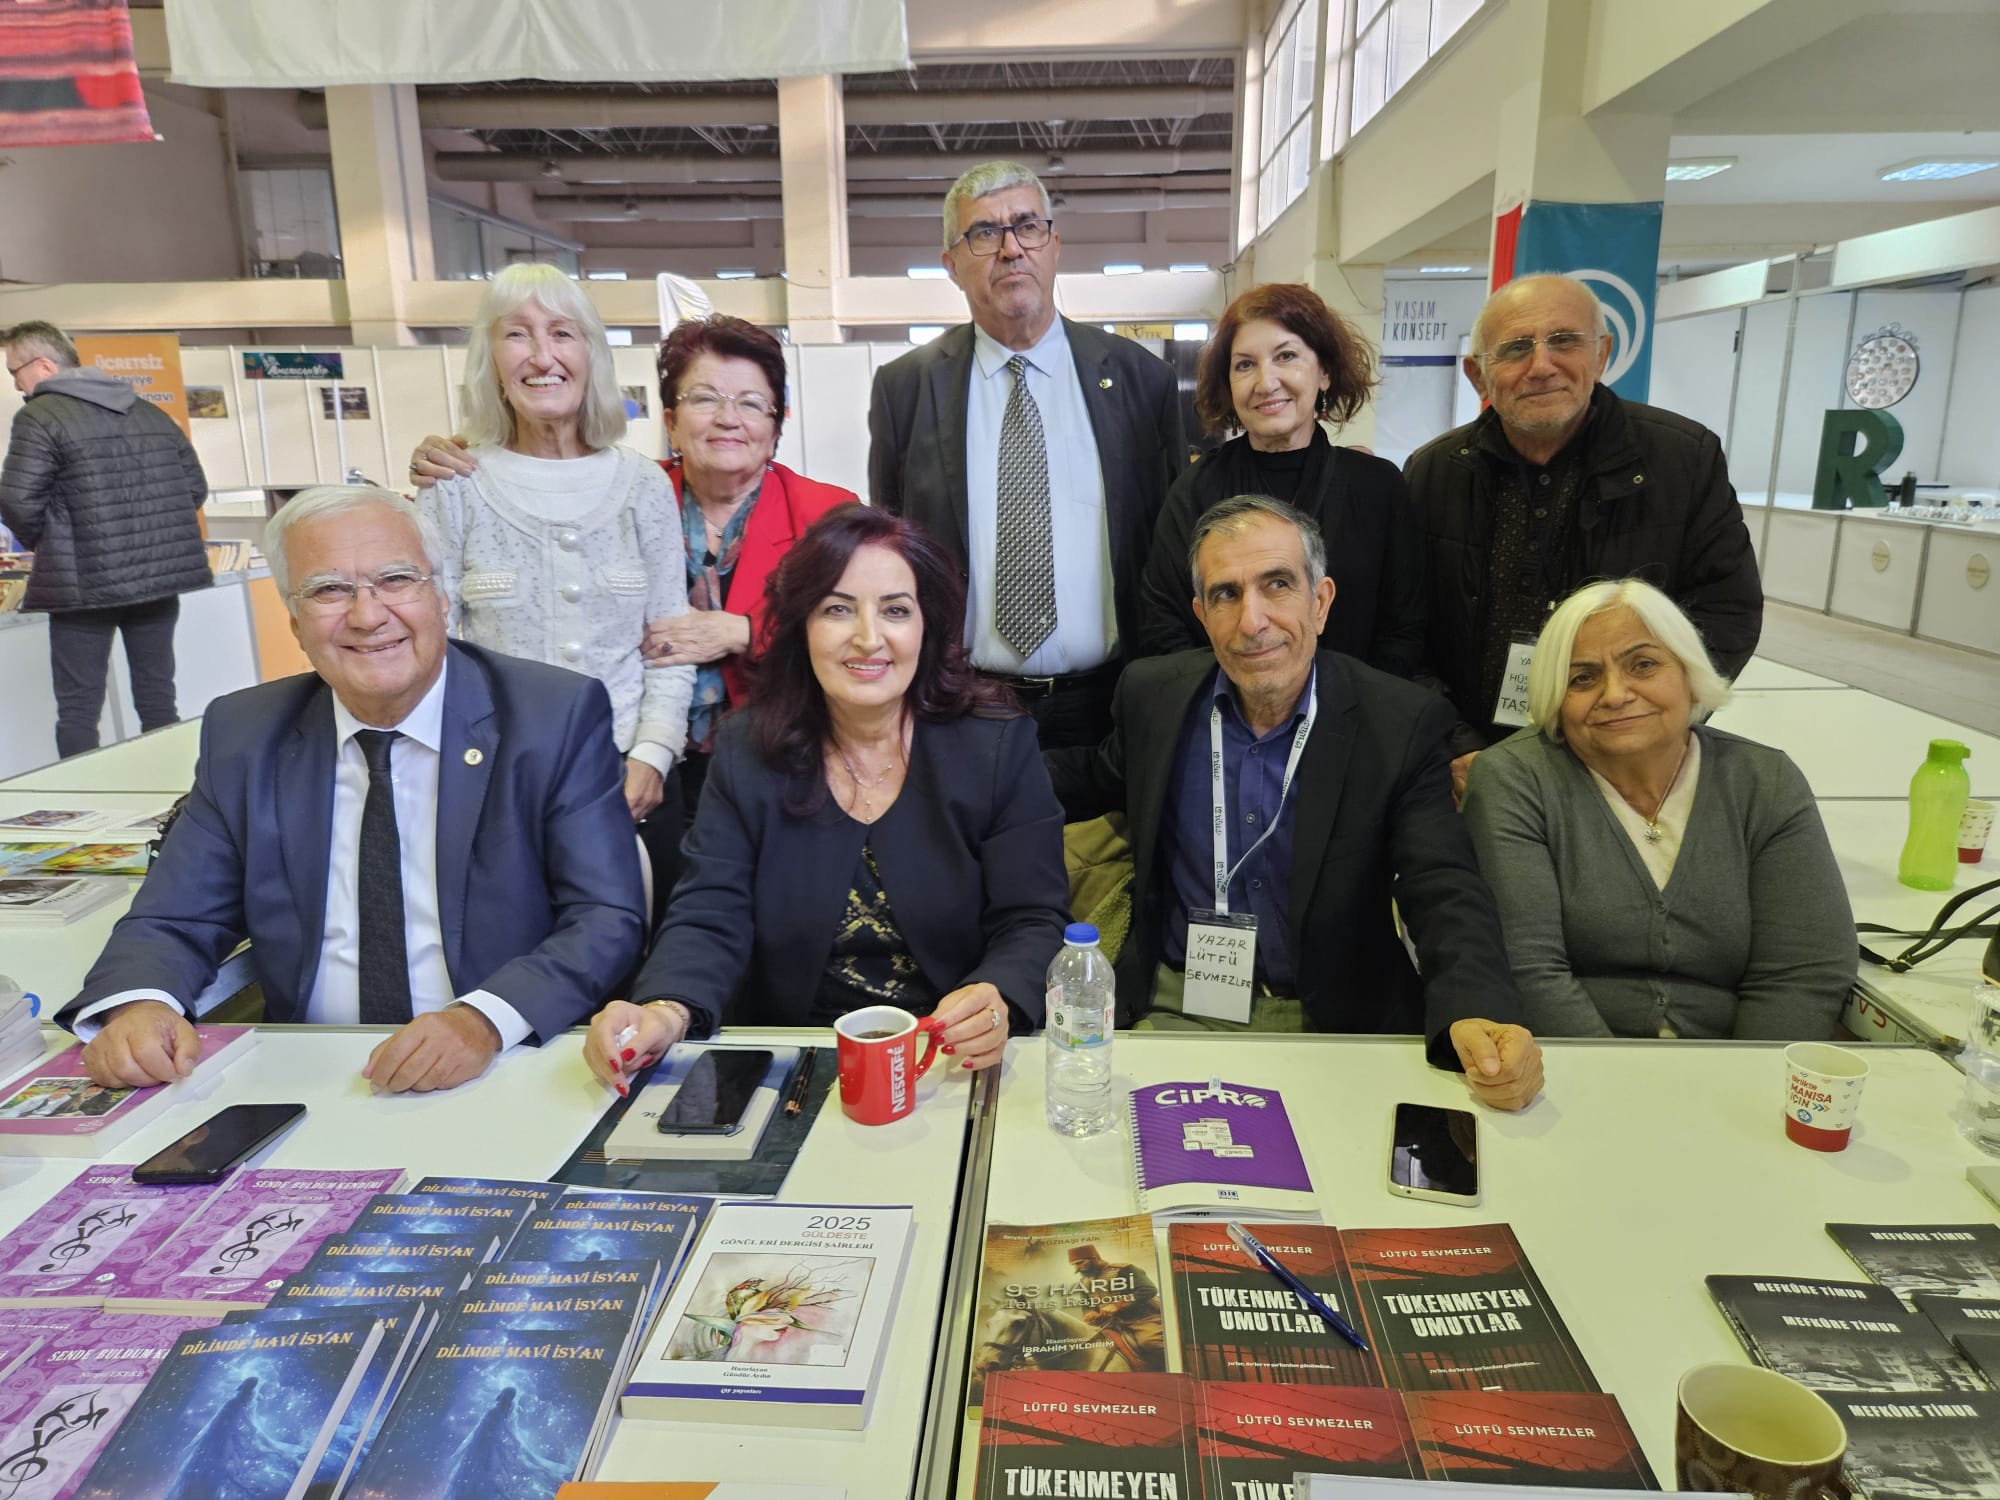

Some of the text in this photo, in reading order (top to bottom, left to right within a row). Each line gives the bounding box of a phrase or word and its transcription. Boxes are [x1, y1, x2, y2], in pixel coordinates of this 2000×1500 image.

[1393, 322, 1448, 341] KONSEPT
[1812, 407, 1905, 510] R
[1197, 933, 1247, 951] YAZAR
[1189, 947, 1238, 966] LÜTFÜ
[1186, 968, 1252, 989] SEVMEZLER
[85, 1176, 123, 1185] SENDE
[252, 1180, 288, 1189] SENDE
[290, 1180, 336, 1189] BULDUM
[421, 1183, 549, 1199] DİLİMDE MAVİ İSYAN
[373, 1203, 514, 1218] DİLİMDE MAVİ İSYAN
[565, 1200, 700, 1213] DİLİMDE MAVİ İSYAN
[532, 1218, 676, 1233] DİLİMDE MAVİ İSYAN
[807, 1215, 872, 1231] 2025
[801, 1230, 868, 1240] GÜLDESTE
[1929, 1231, 1977, 1240] TİMUR
[326, 1243, 475, 1257] DİLİMDE MAVİ İSYAN
[1203, 1243, 1240, 1252] LÜTFÜ
[1379, 1246, 1493, 1259] LÜTFÜ SEVMEZLER
[484, 1270, 640, 1285] DİLİMDE MAVİ İSYAN
[287, 1283, 445, 1297] DİLİMDE MAVİ İSYAN
[1004, 1272, 1135, 1299] 93 HARBİ
[1818, 1285, 1868, 1299] TİMUR
[462, 1297, 624, 1314] DİLİMDE MAVİ İSYAN
[1063, 1291, 1137, 1308] Raporu
[1382, 1288, 1532, 1315] TÜKENMEYEN
[1219, 1310, 1327, 1334] UMUTLAR
[1410, 1312, 1523, 1338] UMUTLAR
[1849, 1319, 1902, 1333] TİMUR
[180, 1331, 354, 1356] DİLİMDE MAVİ İSYAN
[1022, 1340, 1115, 1354] İBRAHİM YILDIRIM
[47, 1349, 96, 1362] SENDE
[97, 1348, 154, 1362] BULDUM
[435, 1343, 605, 1360] DİLİMDE MAVİ İSYAN
[1023, 1401, 1157, 1415] LÜTFÜ SEVMEZLER
[1921, 1403, 1979, 1417] TİMUR
[1236, 1414, 1374, 1430] LÜTFÜ SEVMEZLER
[1455, 1422, 1596, 1438] LÜTFÜ SEVMEZLER
[1004, 1465, 1179, 1500] TÜKENMEYEN
